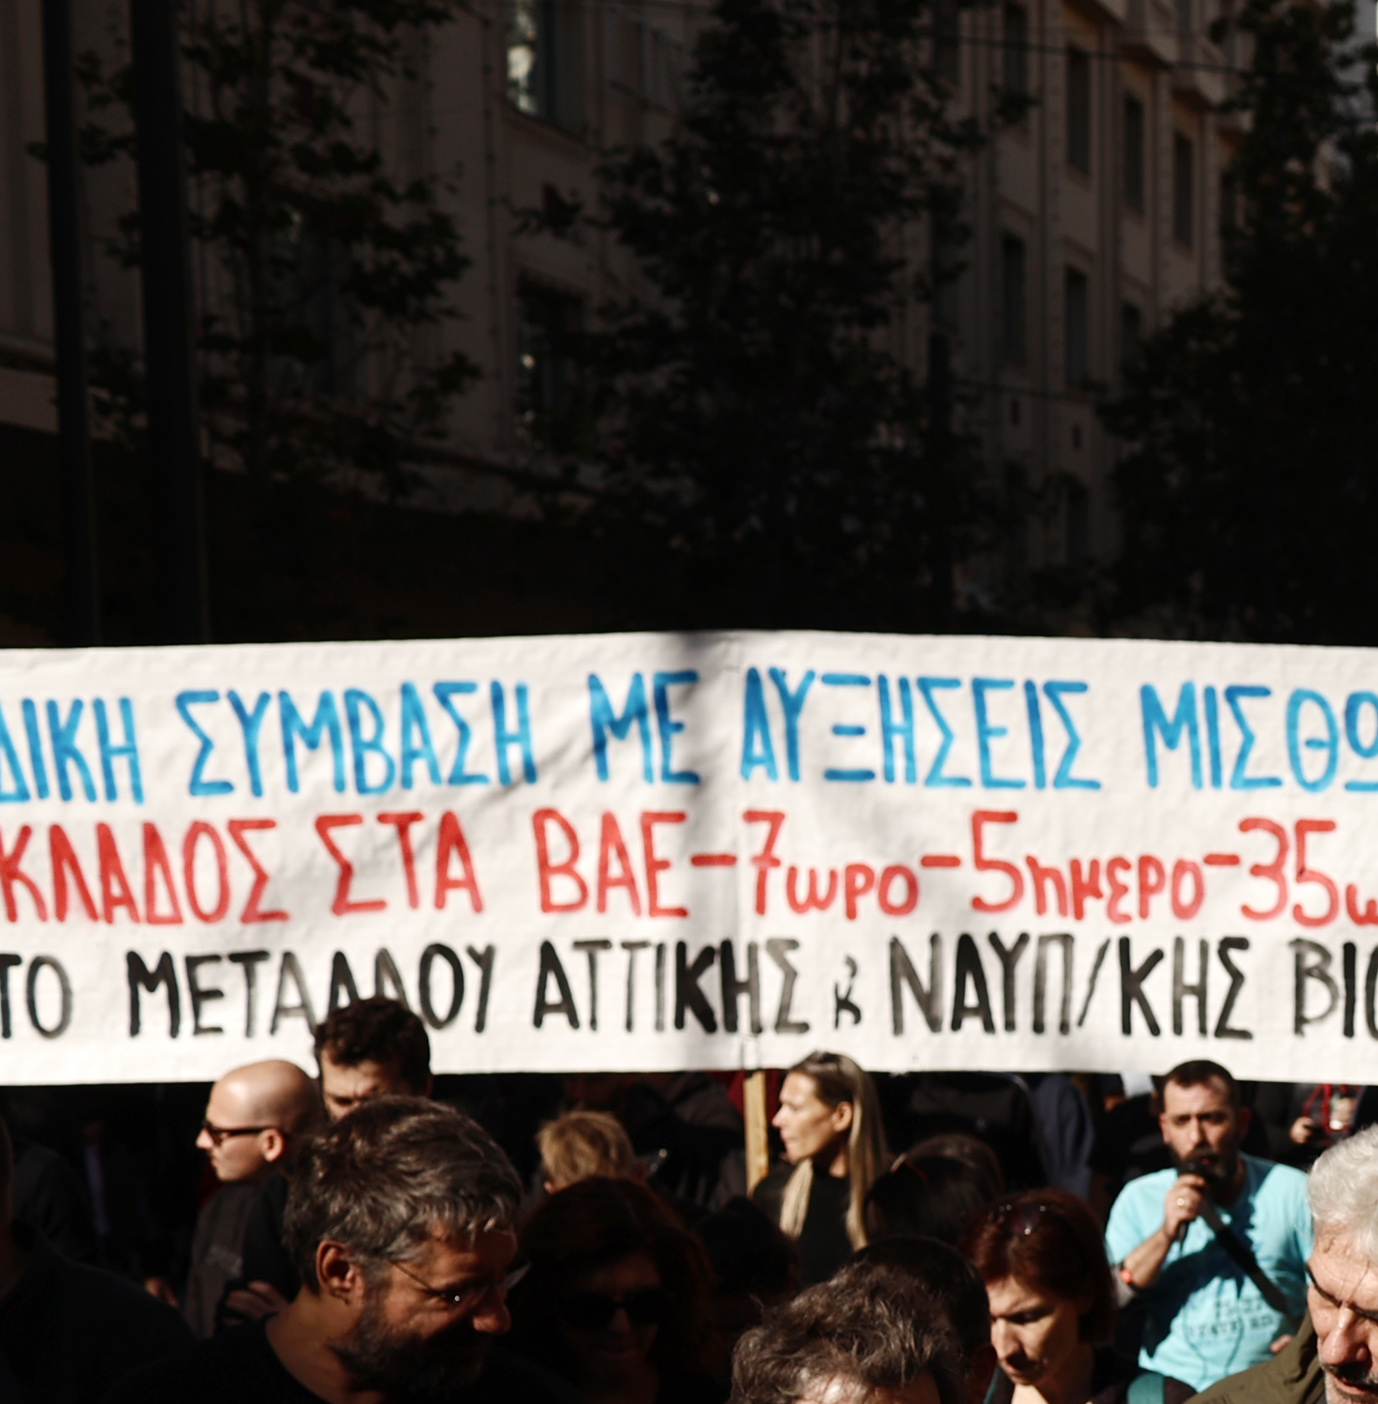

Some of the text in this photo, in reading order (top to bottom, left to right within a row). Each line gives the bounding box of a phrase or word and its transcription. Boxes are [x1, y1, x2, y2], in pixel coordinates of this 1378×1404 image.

[176, 681, 538, 798] ΣΥΜΒΑΣΗ
[588, 671, 700, 785] ΜΕ
[741, 667, 1102, 790] ΑΥΞΗΣΕΙΣ
[0, 818, 290, 926] ΚΛΑΔΟΣ
[314, 810, 484, 918] ΣΤΑ
[127, 943, 495, 1038] ΜΕΤΑΛΛΟΥ
[534, 938, 810, 1035] ΑΤΤΙΚΗΣ
[889, 931, 1253, 1041] ΝΑΥΠ/ΚΗΣ
